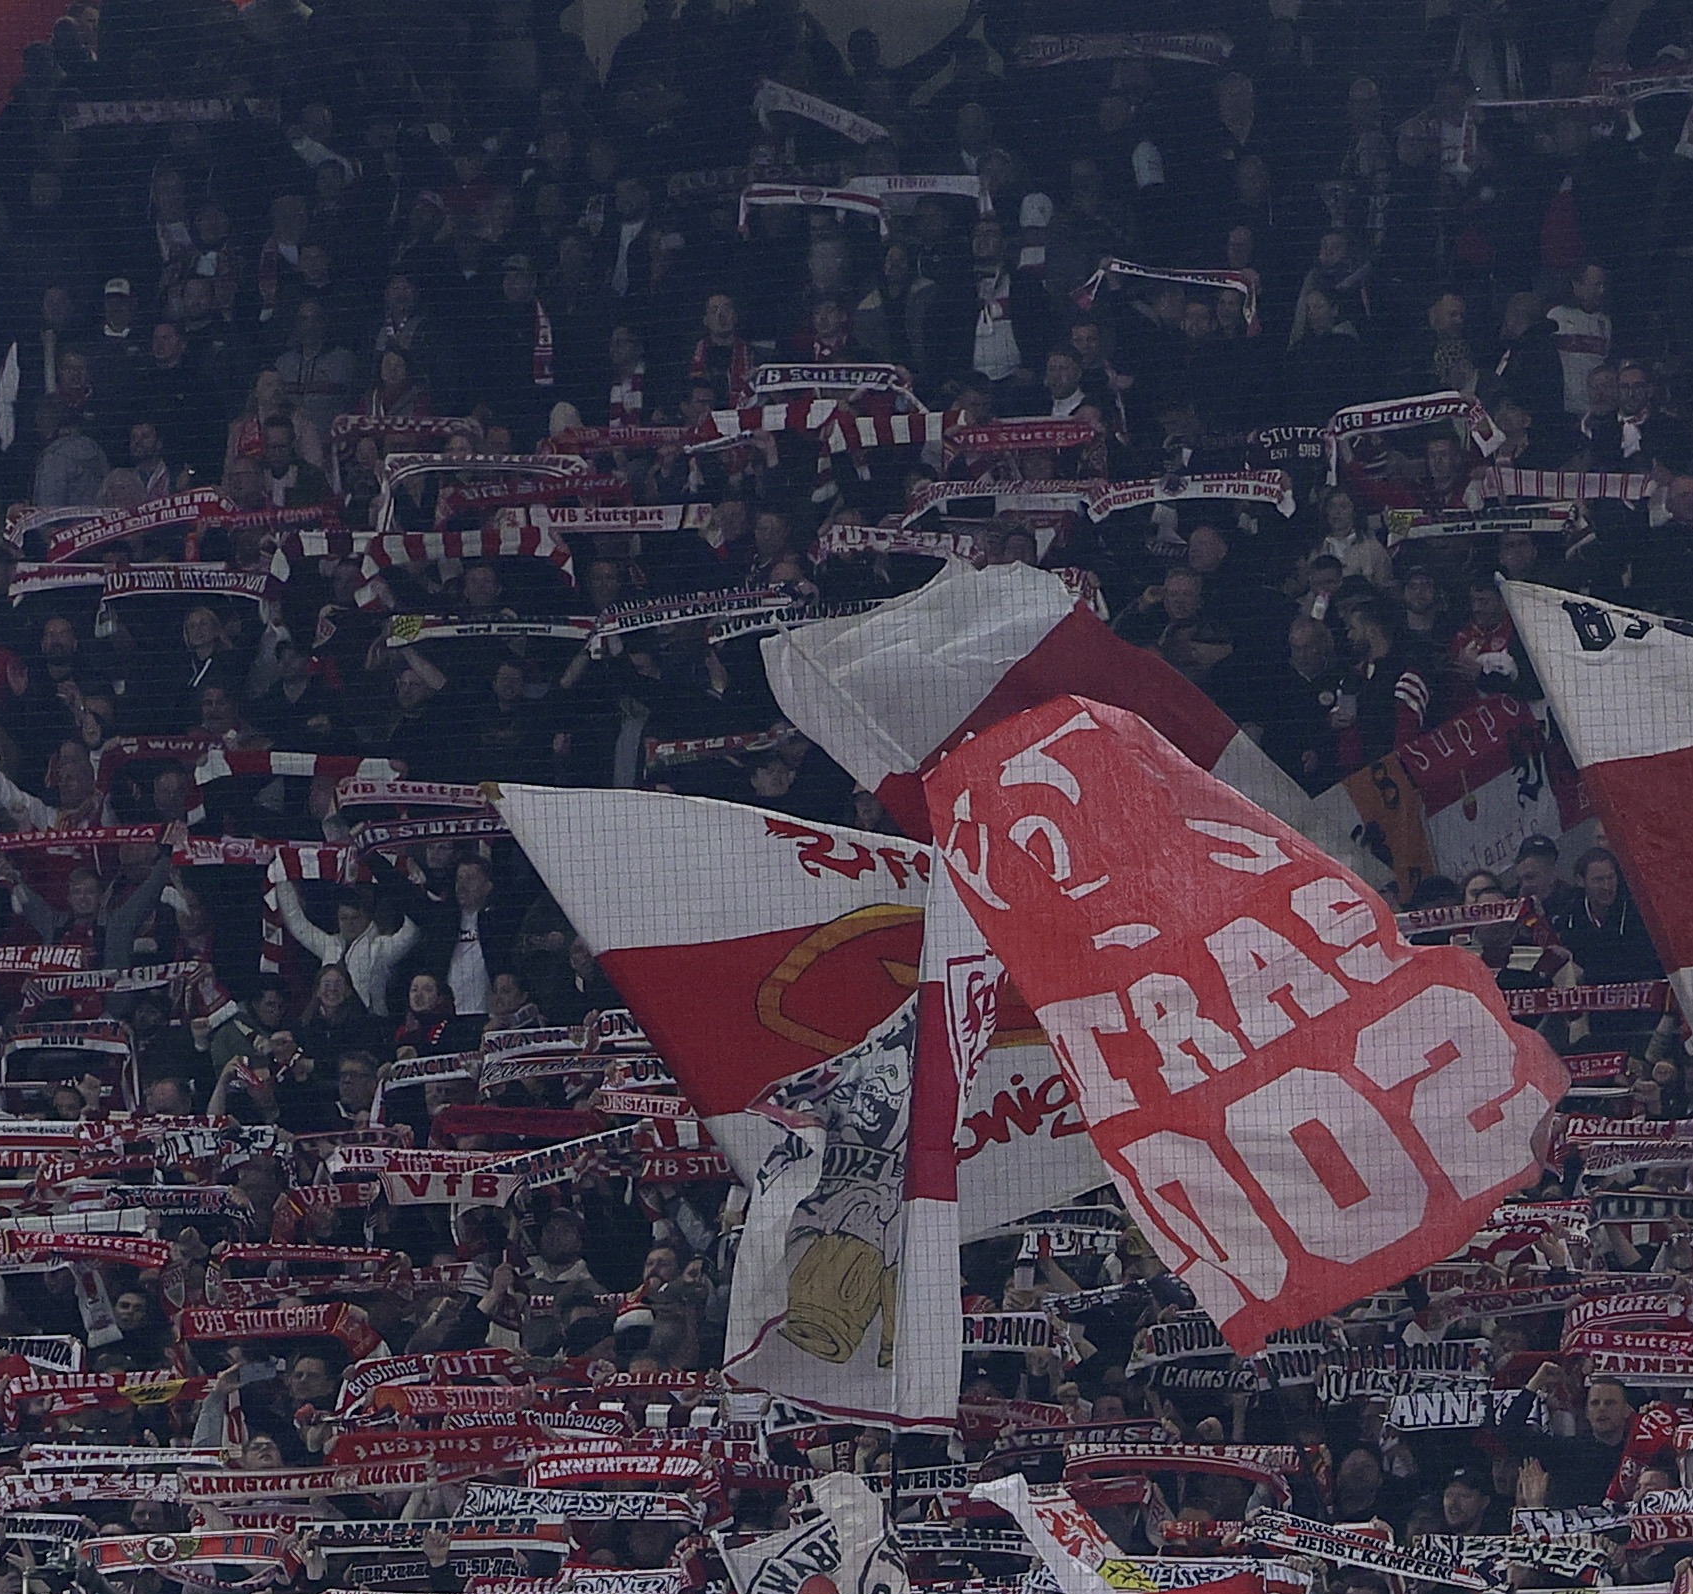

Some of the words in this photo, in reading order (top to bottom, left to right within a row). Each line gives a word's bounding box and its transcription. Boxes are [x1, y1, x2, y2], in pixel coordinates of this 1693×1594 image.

[582, 506, 663, 524] Stuttgart
[349, 1356, 420, 1396] Brustring
[522, 1410, 623, 1436] Tannhausen
[539, 1457, 664, 1478] CANNSTATTER
[1294, 1535, 1350, 1561] HEISST
